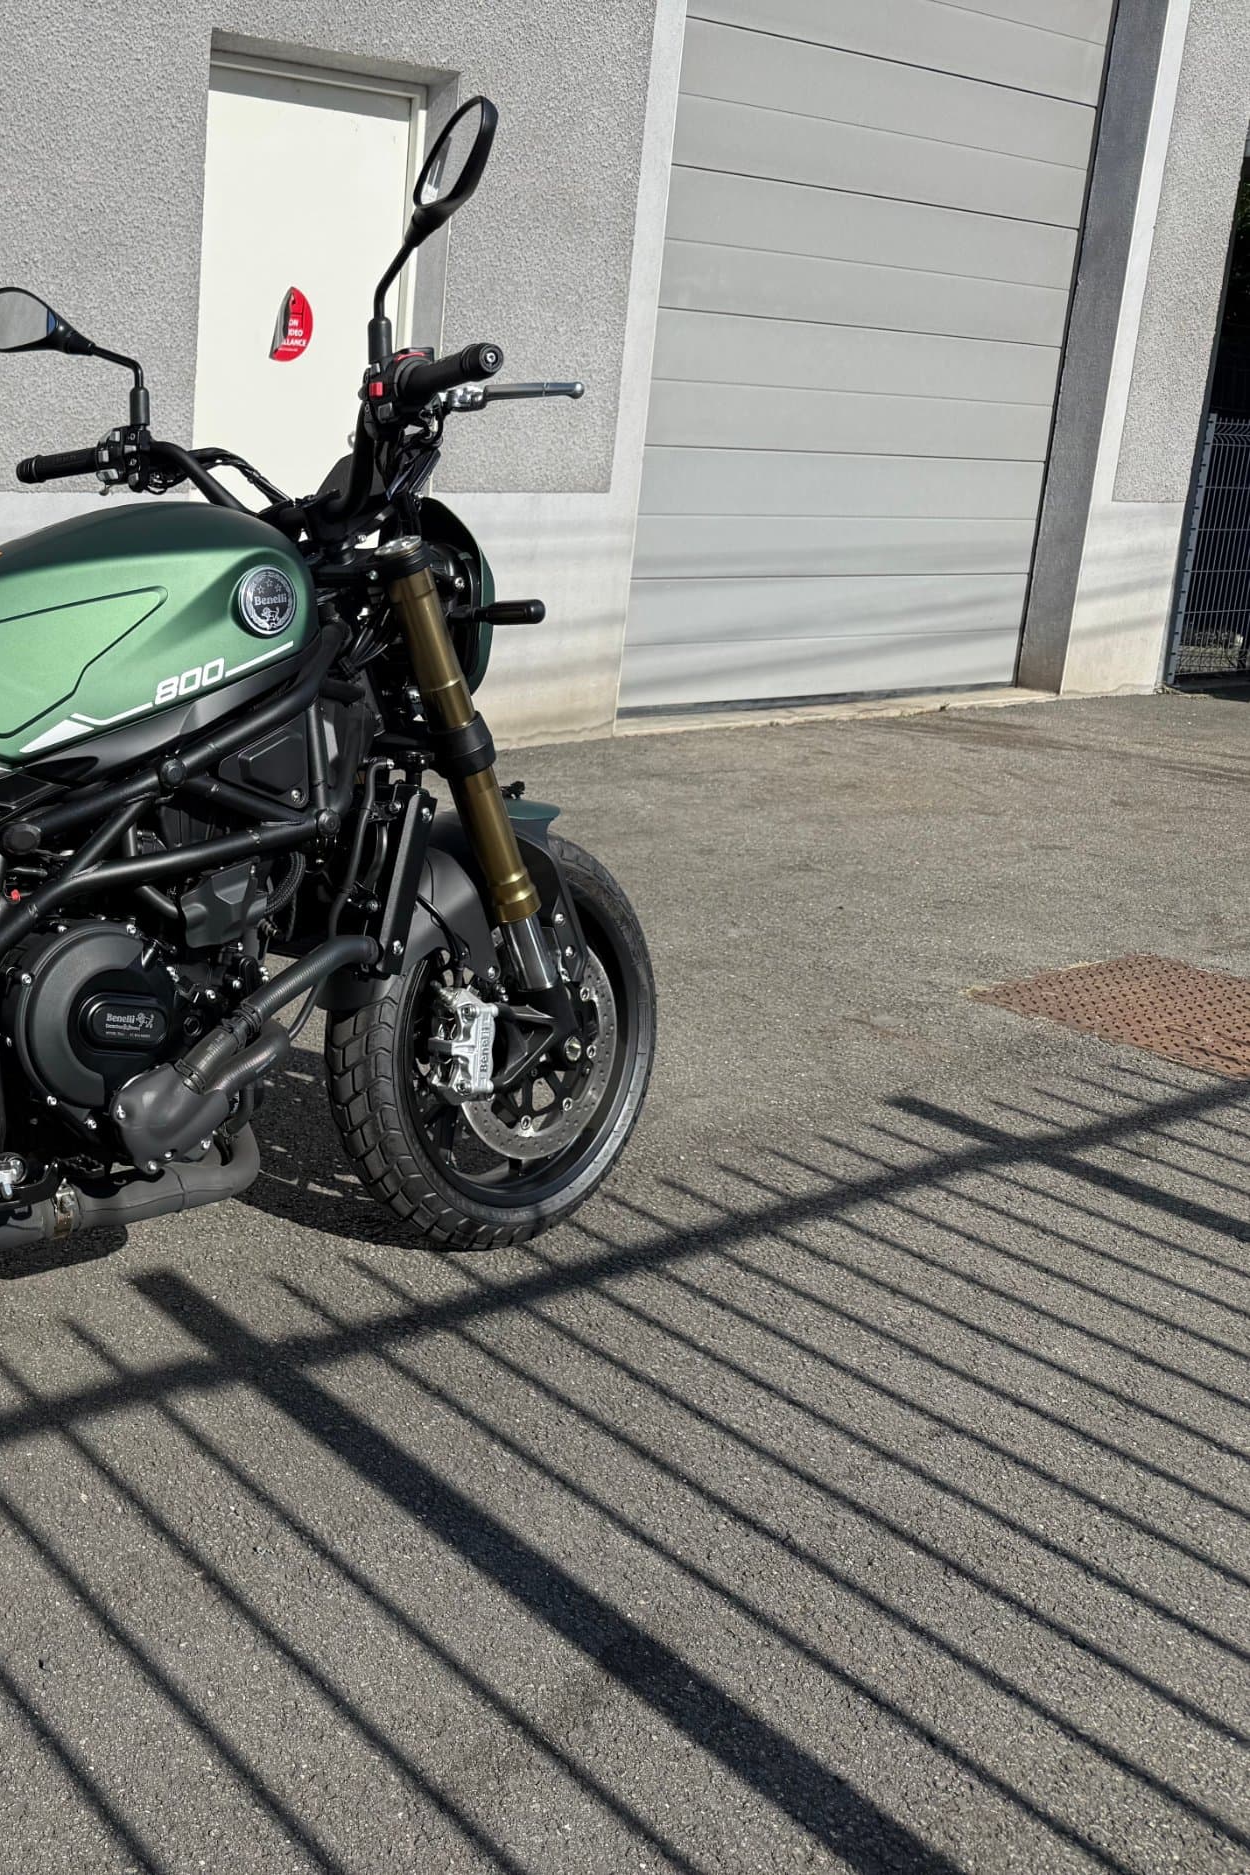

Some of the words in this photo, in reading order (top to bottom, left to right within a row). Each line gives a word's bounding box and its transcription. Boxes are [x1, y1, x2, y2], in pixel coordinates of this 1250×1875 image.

[253, 593, 287, 606] Benelli
[155, 657, 225, 705] 800
[106, 1013, 135, 1024] Benelli
[480, 1025, 490, 1073] Benelli
